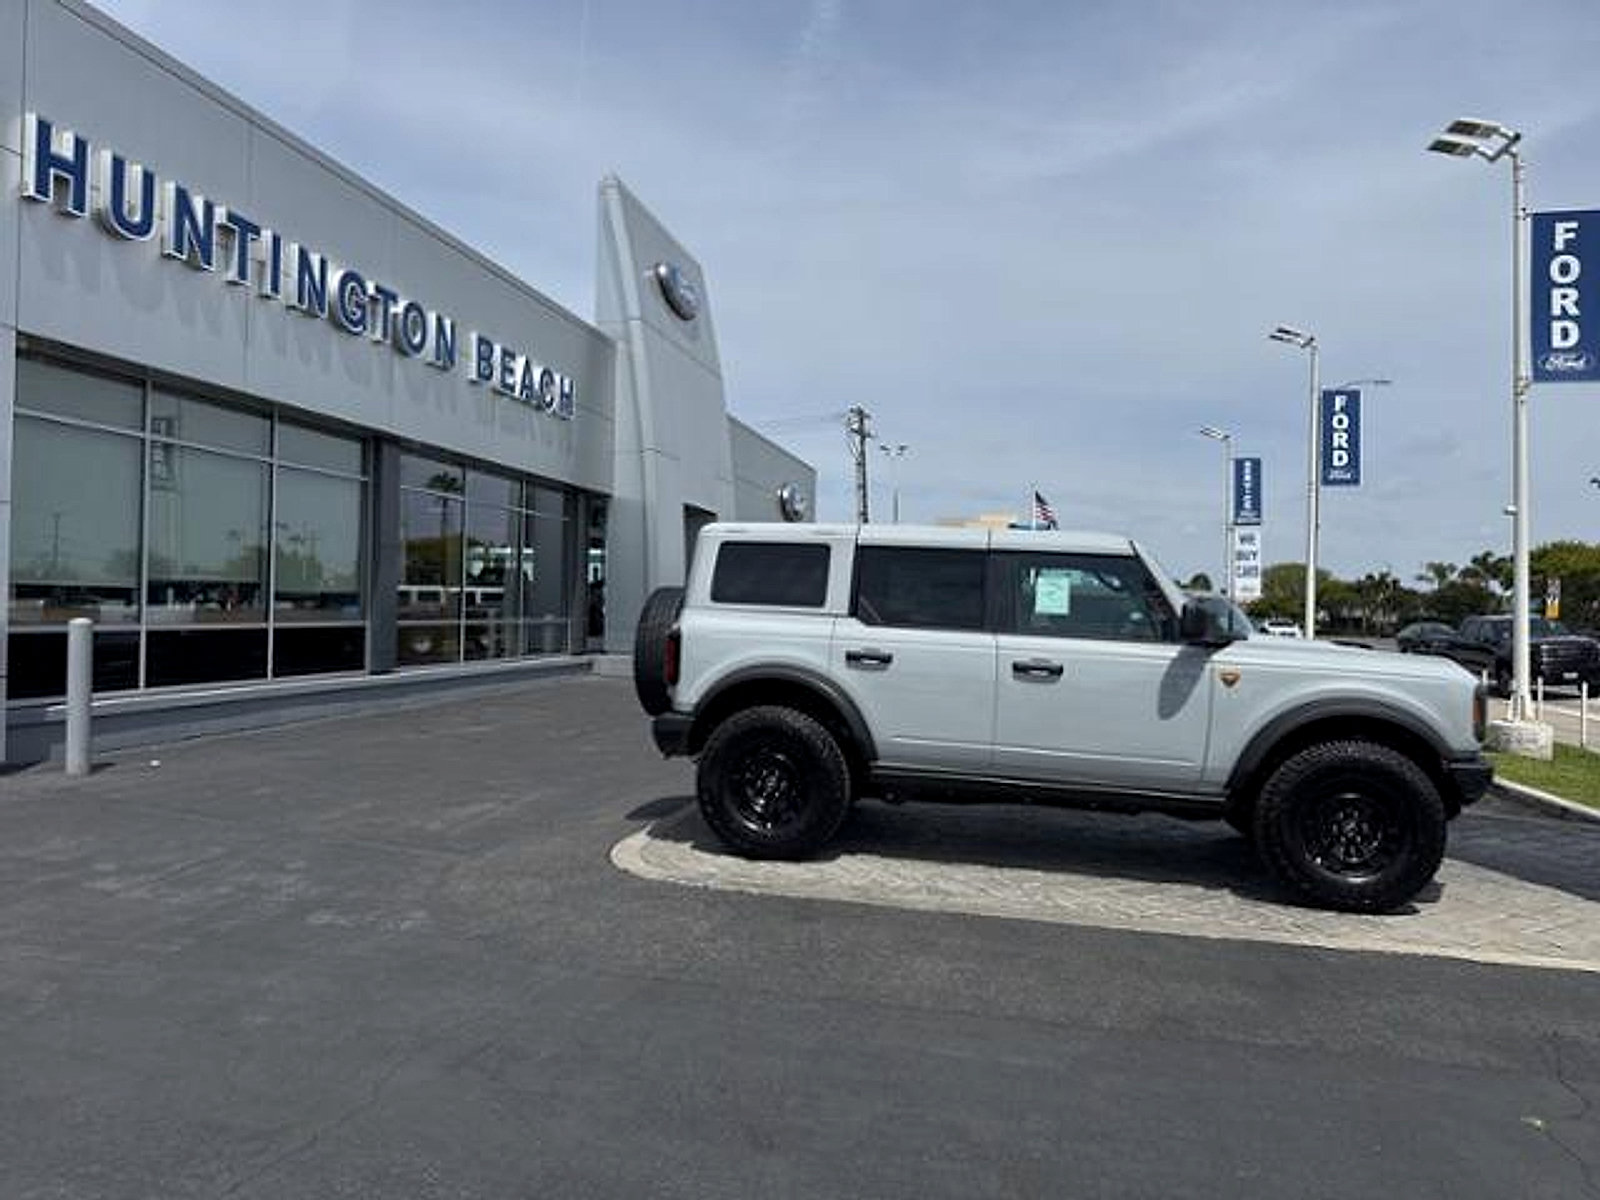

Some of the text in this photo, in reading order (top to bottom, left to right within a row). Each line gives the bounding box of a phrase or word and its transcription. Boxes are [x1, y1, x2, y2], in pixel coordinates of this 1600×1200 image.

[23, 112, 576, 419] HUNTINGTON BEACH
[1549, 221, 1581, 349] FORD
[1331, 395, 1349, 467] FORD
